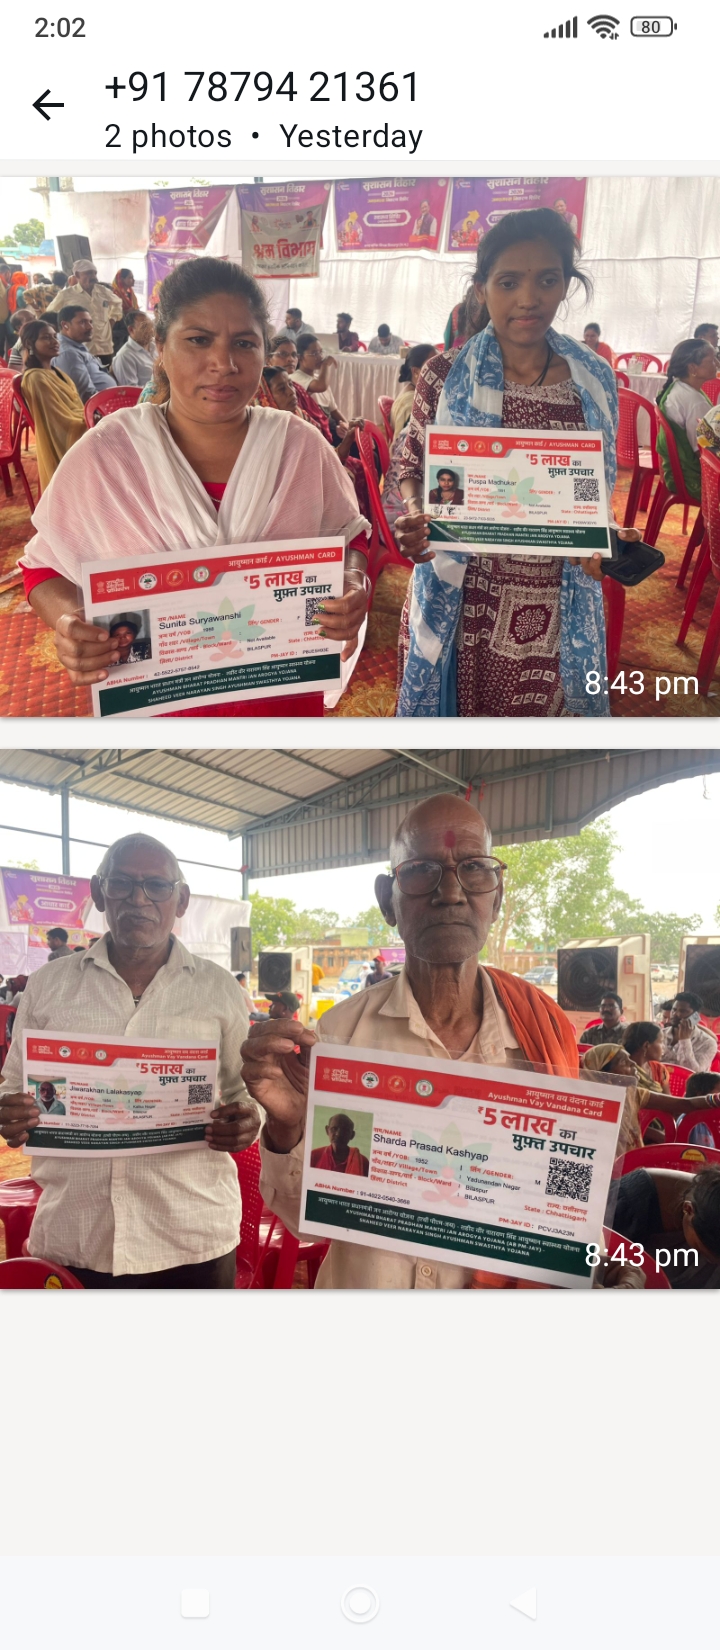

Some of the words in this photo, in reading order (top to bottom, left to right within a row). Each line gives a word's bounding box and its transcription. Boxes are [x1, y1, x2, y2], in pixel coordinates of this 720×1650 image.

[34, 18, 86, 38] 2:02
[641, 20, 660, 34] 80
[105, 70, 169, 104] +91
[184, 70, 297, 102] 78794
[309, 70, 419, 102] 21361
[105, 125, 121, 147] 2
[132, 123, 232, 153] photos
[280, 123, 423, 153] Yesterday
[254, 244, 275, 259] श्रम
[276, 238, 316, 259] विभाग
[541, 455, 570, 466] लाख
[229, 559, 254, 568] आयुष्मान
[276, 553, 314, 562] AYUSHMAN
[264, 570, 303, 588] लाख
[273, 587, 298, 602] मुफ़्त
[300, 584, 332, 596] उपचार
[159, 620, 186, 630] Sunita
[189, 612, 241, 626] Suryawanshi
[151, 1063, 184, 1075] लाख
[488, 1092, 527, 1104] Ayushman
[530, 1099, 544, 1108] Vay
[546, 1102, 581, 1113] Vandana
[583, 1108, 602, 1117] Card
[526, 1090, 555, 1100] आयुष्मान
[569, 1095, 587, 1105] वंदना
[589, 1100, 604, 1108] कार्ड
[500, 1110, 557, 1136] लाख
[559, 1128, 577, 1140] का
[373, 1134, 406, 1147] Sharda
[409, 1140, 443, 1153] Prasad
[446, 1147, 489, 1162] Kashyap
[512, 1134, 546, 1151] मुफ़्त
[549, 1140, 596, 1160] उपचार
[332, 1185, 355, 1194] Number
[386, 1178, 408, 1187] District
[465, 1185, 488, 1194] Bilaspur
[467, 1176, 501, 1187] Yadunandan
[503, 1183, 521, 1191] Nagar
[465, 1194, 495, 1205] BILASPUR
[498, 1217, 522, 1227] PM-JAY
[524, 1205, 540, 1213] State
[546, 1210, 587, 1222] Chhattisgarh
[346, 1210, 375, 1219] AYUSHMAN
[398, 1219, 424, 1229] PRADHAN
[458, 1231, 482, 1240] AROGYA
[483, 1236, 505, 1244] YOJANA
[474, 1240, 506, 1251] SWASTHYA
[507, 1247, 530, 1256] YOJANA
